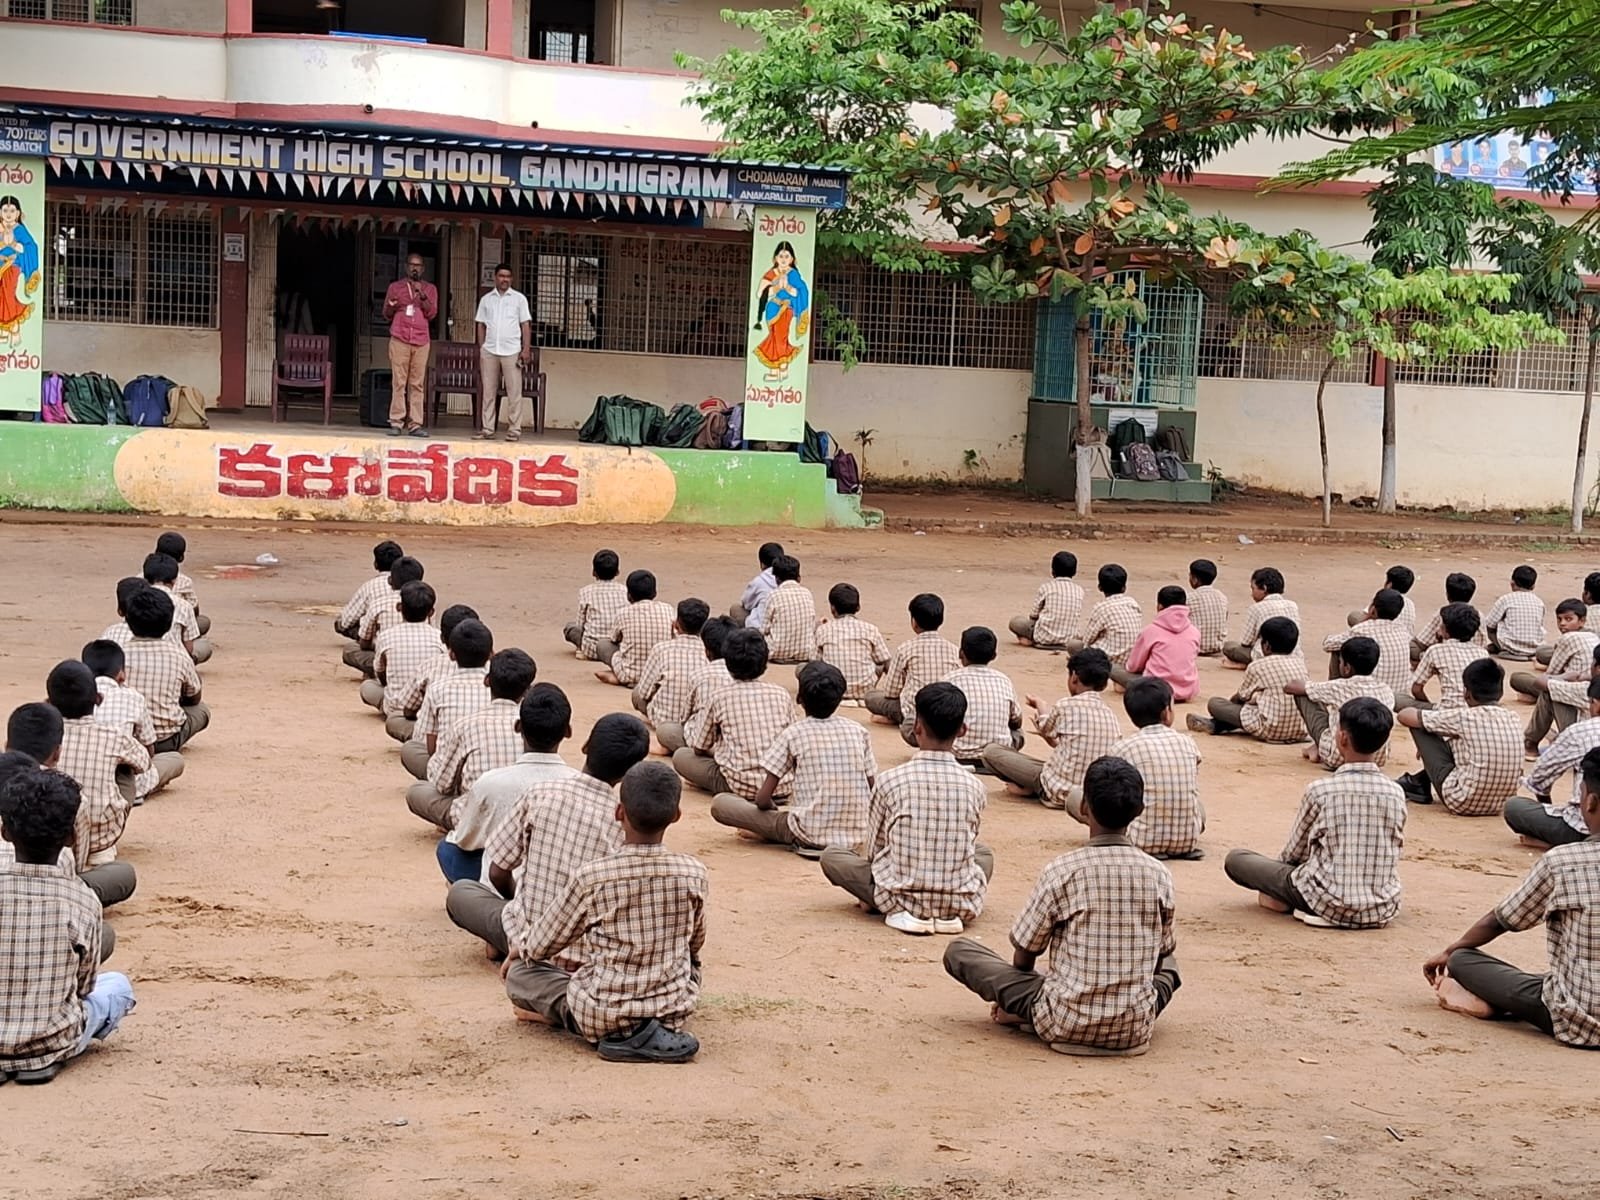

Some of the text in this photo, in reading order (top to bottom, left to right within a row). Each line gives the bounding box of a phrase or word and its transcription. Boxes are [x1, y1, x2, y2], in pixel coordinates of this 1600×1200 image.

[13, 141, 42, 153] BATCH
[50, 121, 733, 200] GOVERNMENT HIGH SCHOOL, GANDHIGRAM.
[738, 170, 809, 187] CHODAVARAM
